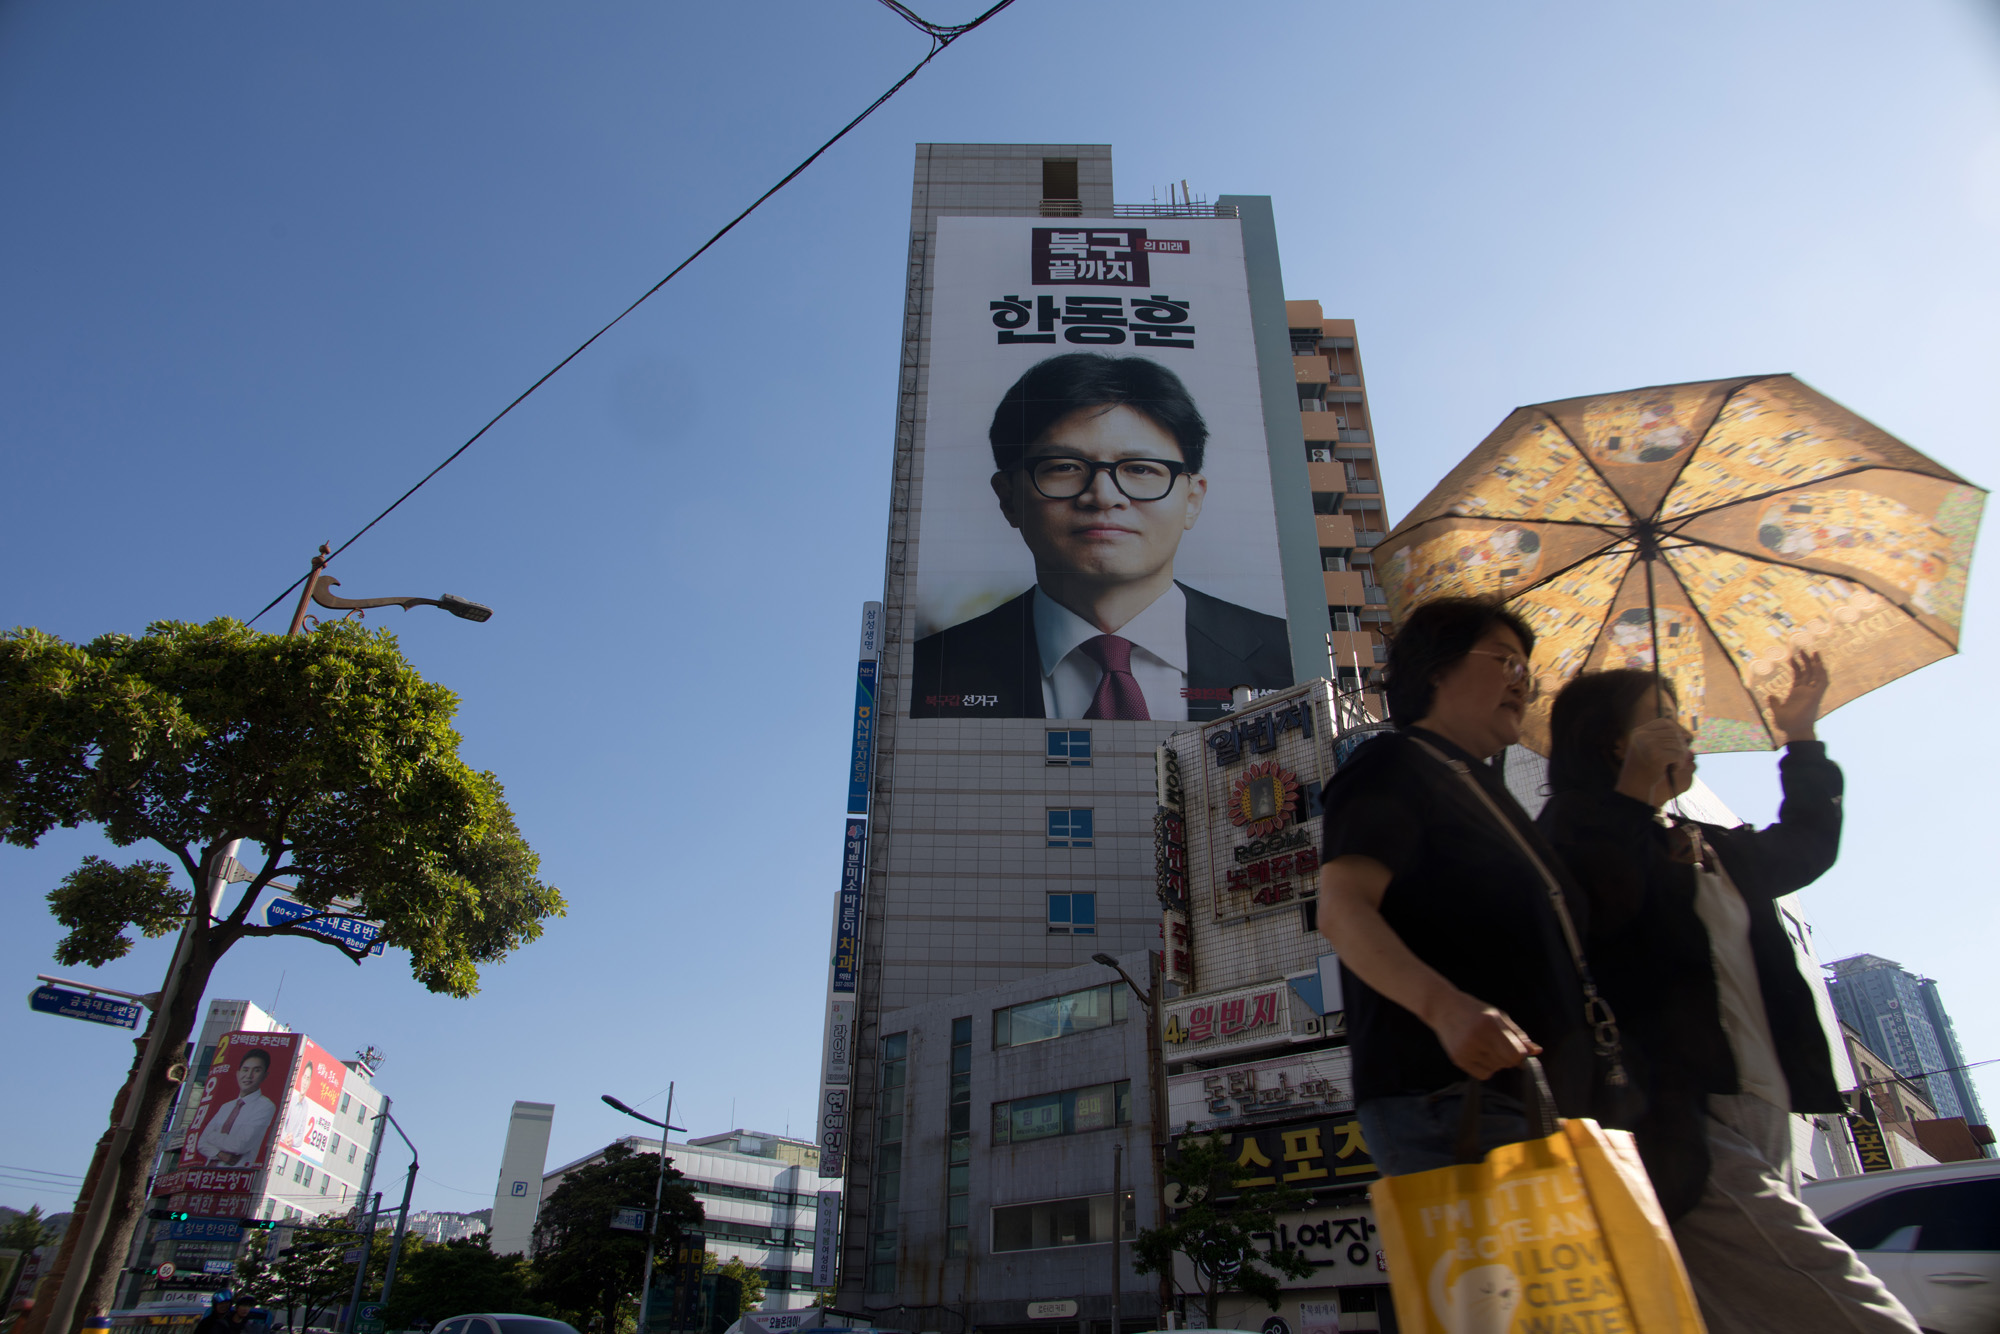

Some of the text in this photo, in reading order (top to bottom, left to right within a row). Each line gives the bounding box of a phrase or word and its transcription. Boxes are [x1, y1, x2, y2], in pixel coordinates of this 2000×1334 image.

[1049, 231, 1184, 260] 북구 의 미래
[1049, 260, 1134, 282] 끝까지
[990, 294, 1196, 350] 한동훈
[865, 610, 876, 650] 삼성생명
[962, 694, 998, 707] 선거구
[1208, 701, 1312, 768] 일번지
[1166, 819, 1185, 901] 일번지
[1234, 828, 1310, 864] ROOM
[1227, 847, 1320, 892] 노래주점
[272, 905, 285, 915] 100
[1253, 881, 1293, 906] 4F
[837, 937, 855, 973] 치과
[70, 995, 139, 1019] 금곡대로8번길
[1189, 992, 1281, 1042] 일번지
[832, 1024, 848, 1065] 라이브
[1163, 1014, 1189, 1045] 4F
[212, 1034, 291, 1066] 2 강력한 추진력
[183, 1076, 218, 1161] 오태원
[823, 1092, 845, 1154] 연예인
[1078, 1096, 1101, 1117] 임대
[303, 1116, 315, 1145] 2
[1852, 1116, 1890, 1169] 스포츠
[1231, 1120, 1378, 1190] 스포츠
[186, 1170, 253, 1191] 대한보청기
[693, 1269, 700, 1283] 5
[165, 1292, 198, 1302] 이스터
